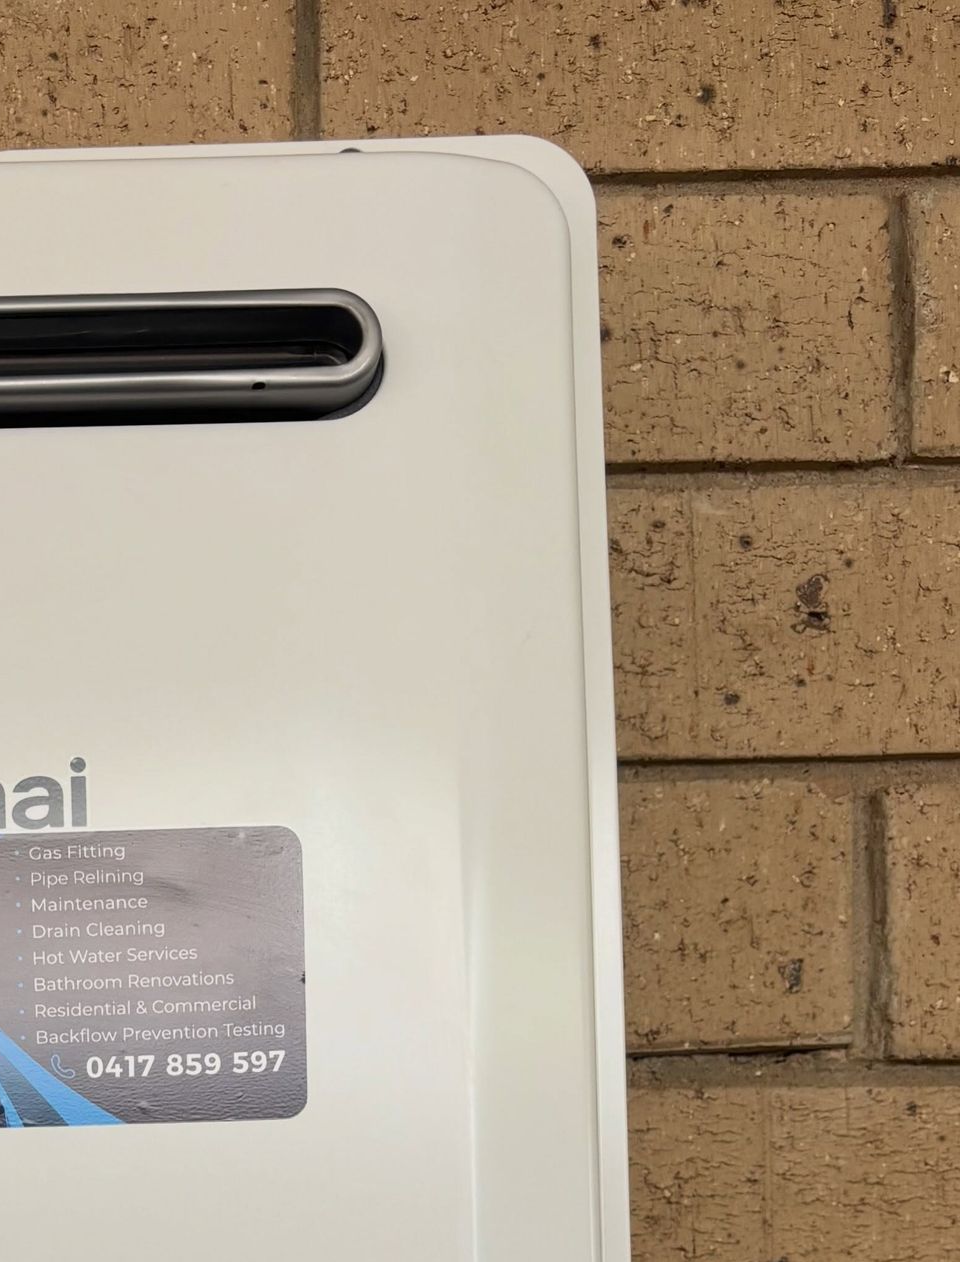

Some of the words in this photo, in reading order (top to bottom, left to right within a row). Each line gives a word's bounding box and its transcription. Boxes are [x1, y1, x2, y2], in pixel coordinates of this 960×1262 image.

[28, 846, 62, 861] Gas
[67, 844, 126, 861] Fitting
[30, 871, 69, 888] Pipe
[73, 869, 144, 886] Relining
[31, 896, 149, 912] Maintenance
[32, 923, 81, 939] Drain
[86, 920, 166, 938] Cleaning
[33, 949, 65, 965] Hot
[69, 948, 123, 964] Water
[127, 946, 198, 962] Services
[34, 974, 123, 992] Bathroom
[128, 971, 235, 989] Renovations
[35, 1001, 132, 1018] Residential
[136, 1000, 148, 1015] &
[152, 996, 257, 1014] Commercial
[36, 1028, 118, 1045] Backflow
[123, 1024, 219, 1042] Prevention
[223, 1022, 286, 1040] Testing
[86, 1055, 155, 1078] 0417
[166, 1053, 222, 1076] 859
[232, 1050, 286, 1074] 597
